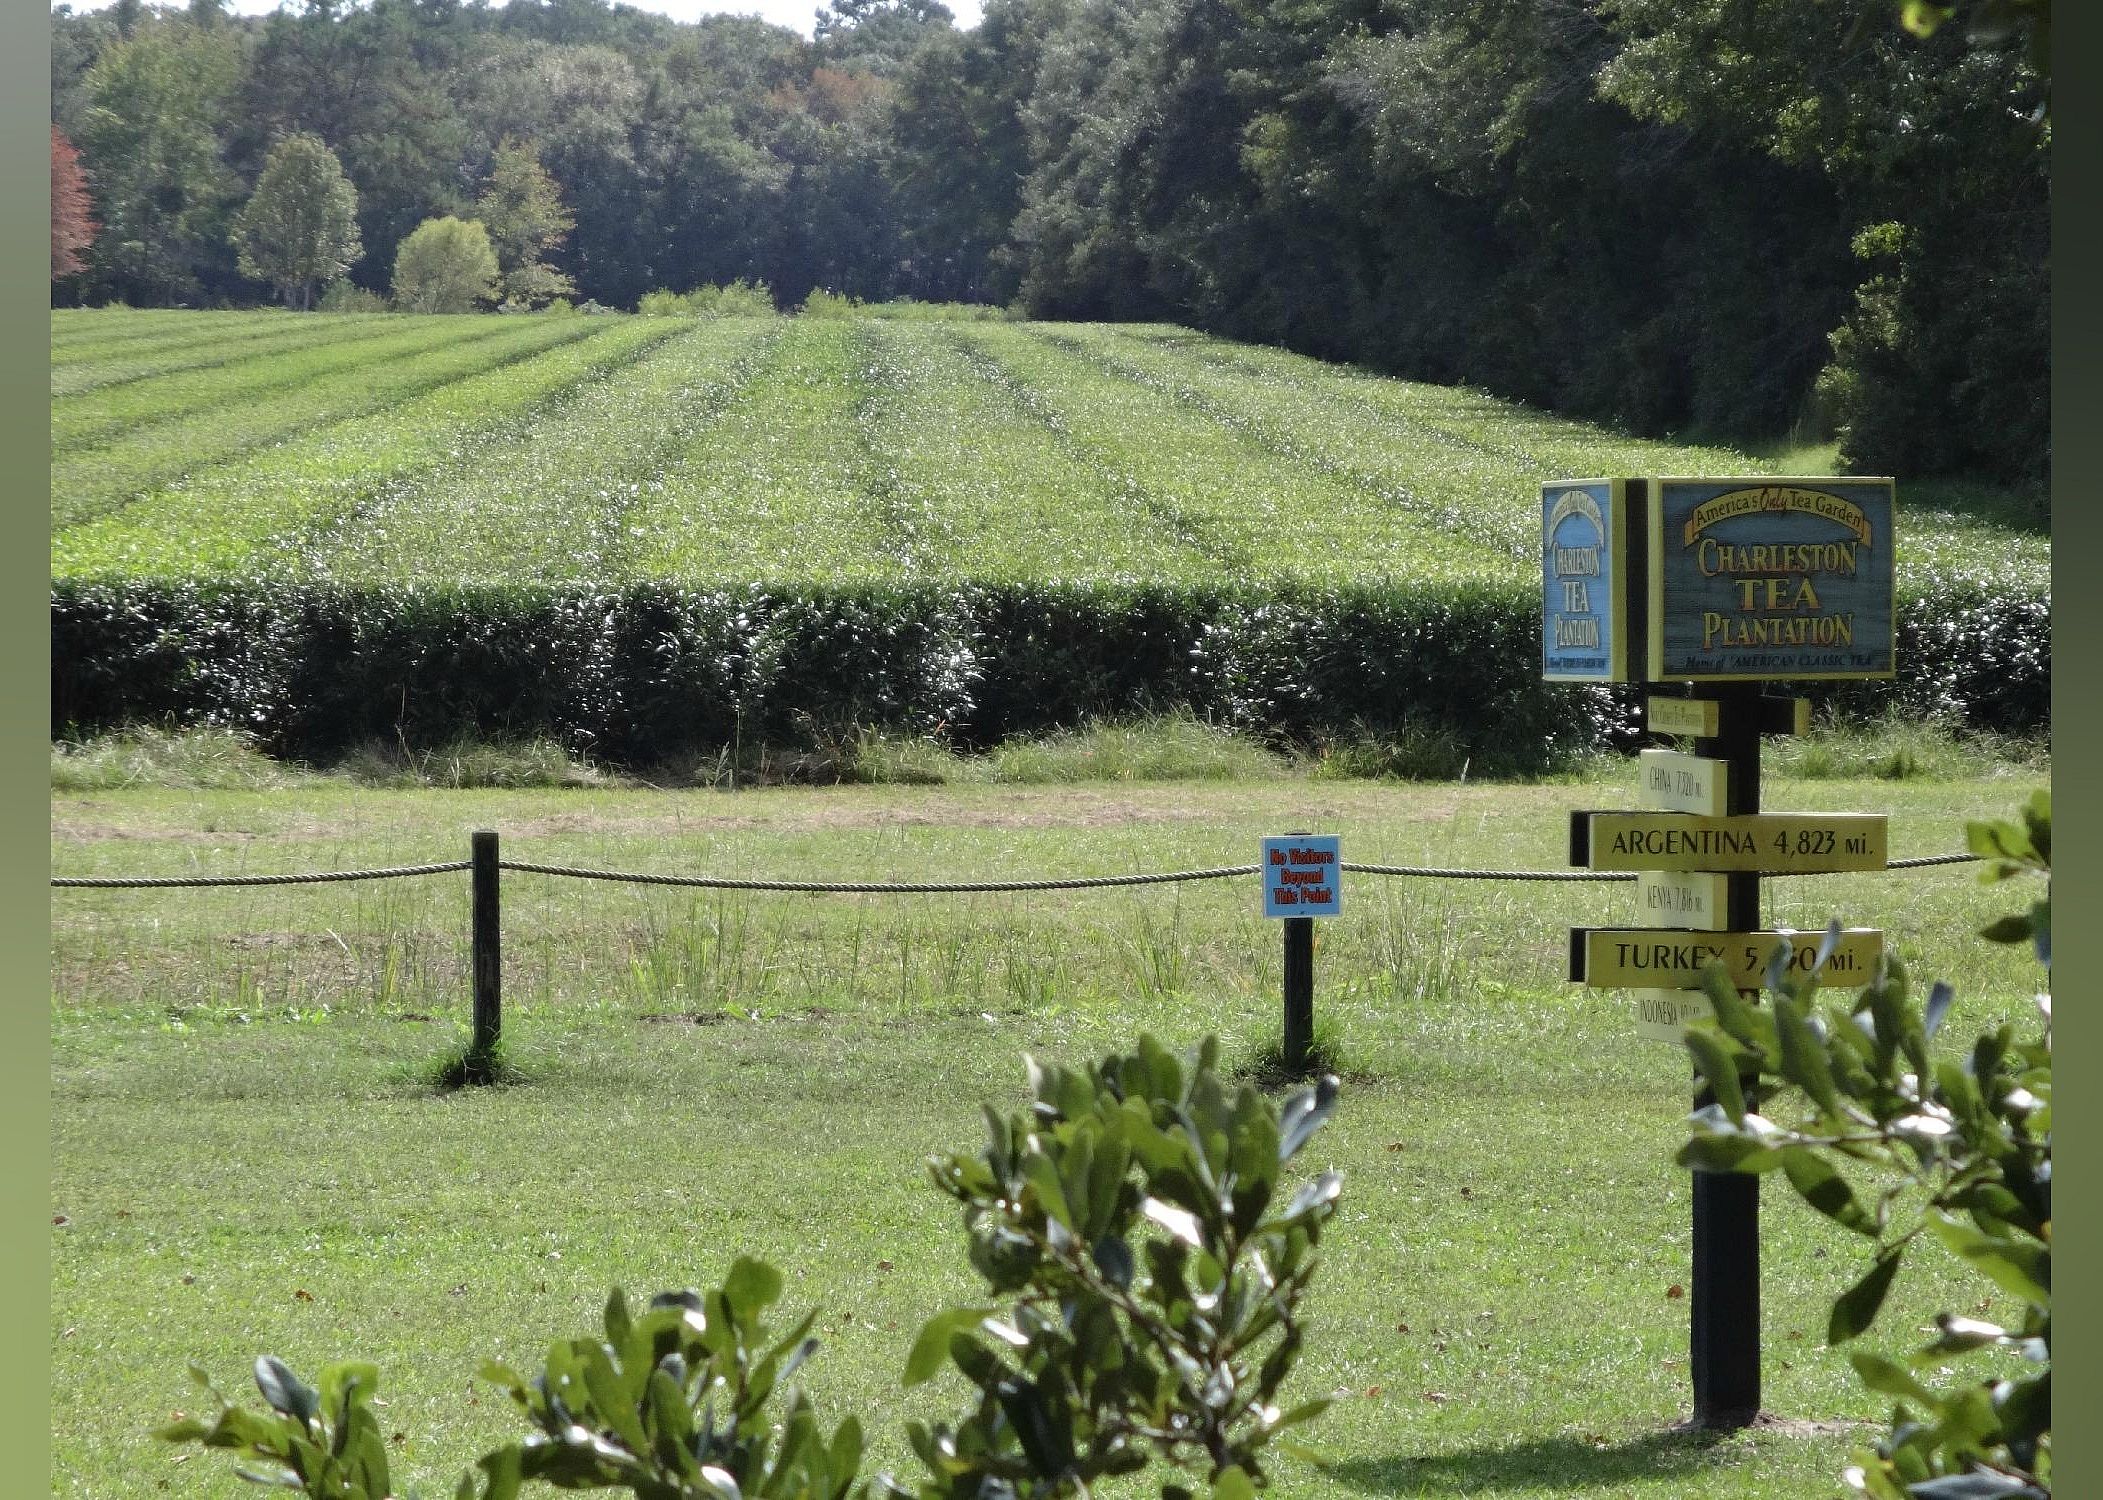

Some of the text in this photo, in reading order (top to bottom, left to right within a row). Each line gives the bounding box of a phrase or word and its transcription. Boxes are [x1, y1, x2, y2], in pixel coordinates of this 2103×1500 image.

[1760, 488, 1788, 512] Only
[1789, 490, 1812, 508] Tea
[1815, 496, 1861, 529] Garden
[1698, 537, 1859, 577] CHARLESTON
[1562, 581, 1590, 612] TEA
[1734, 577, 1822, 611] TEA
[1703, 611, 1856, 650] PLANTATION
[1649, 766, 1671, 793] CHINA
[1269, 847, 1334, 865] No Visitors
[1611, 830, 1757, 855] ARGENTINA
[1773, 830, 1836, 859] 4,823
[1281, 867, 1324, 888] Beyond
[1273, 886, 1333, 904] This Point
[1647, 884, 1672, 911] KENYA
[1615, 943, 1726, 970] TURKEY
[1745, 946, 1818, 977] 5,0
[1640, 999, 1678, 1026] INDONESIA
